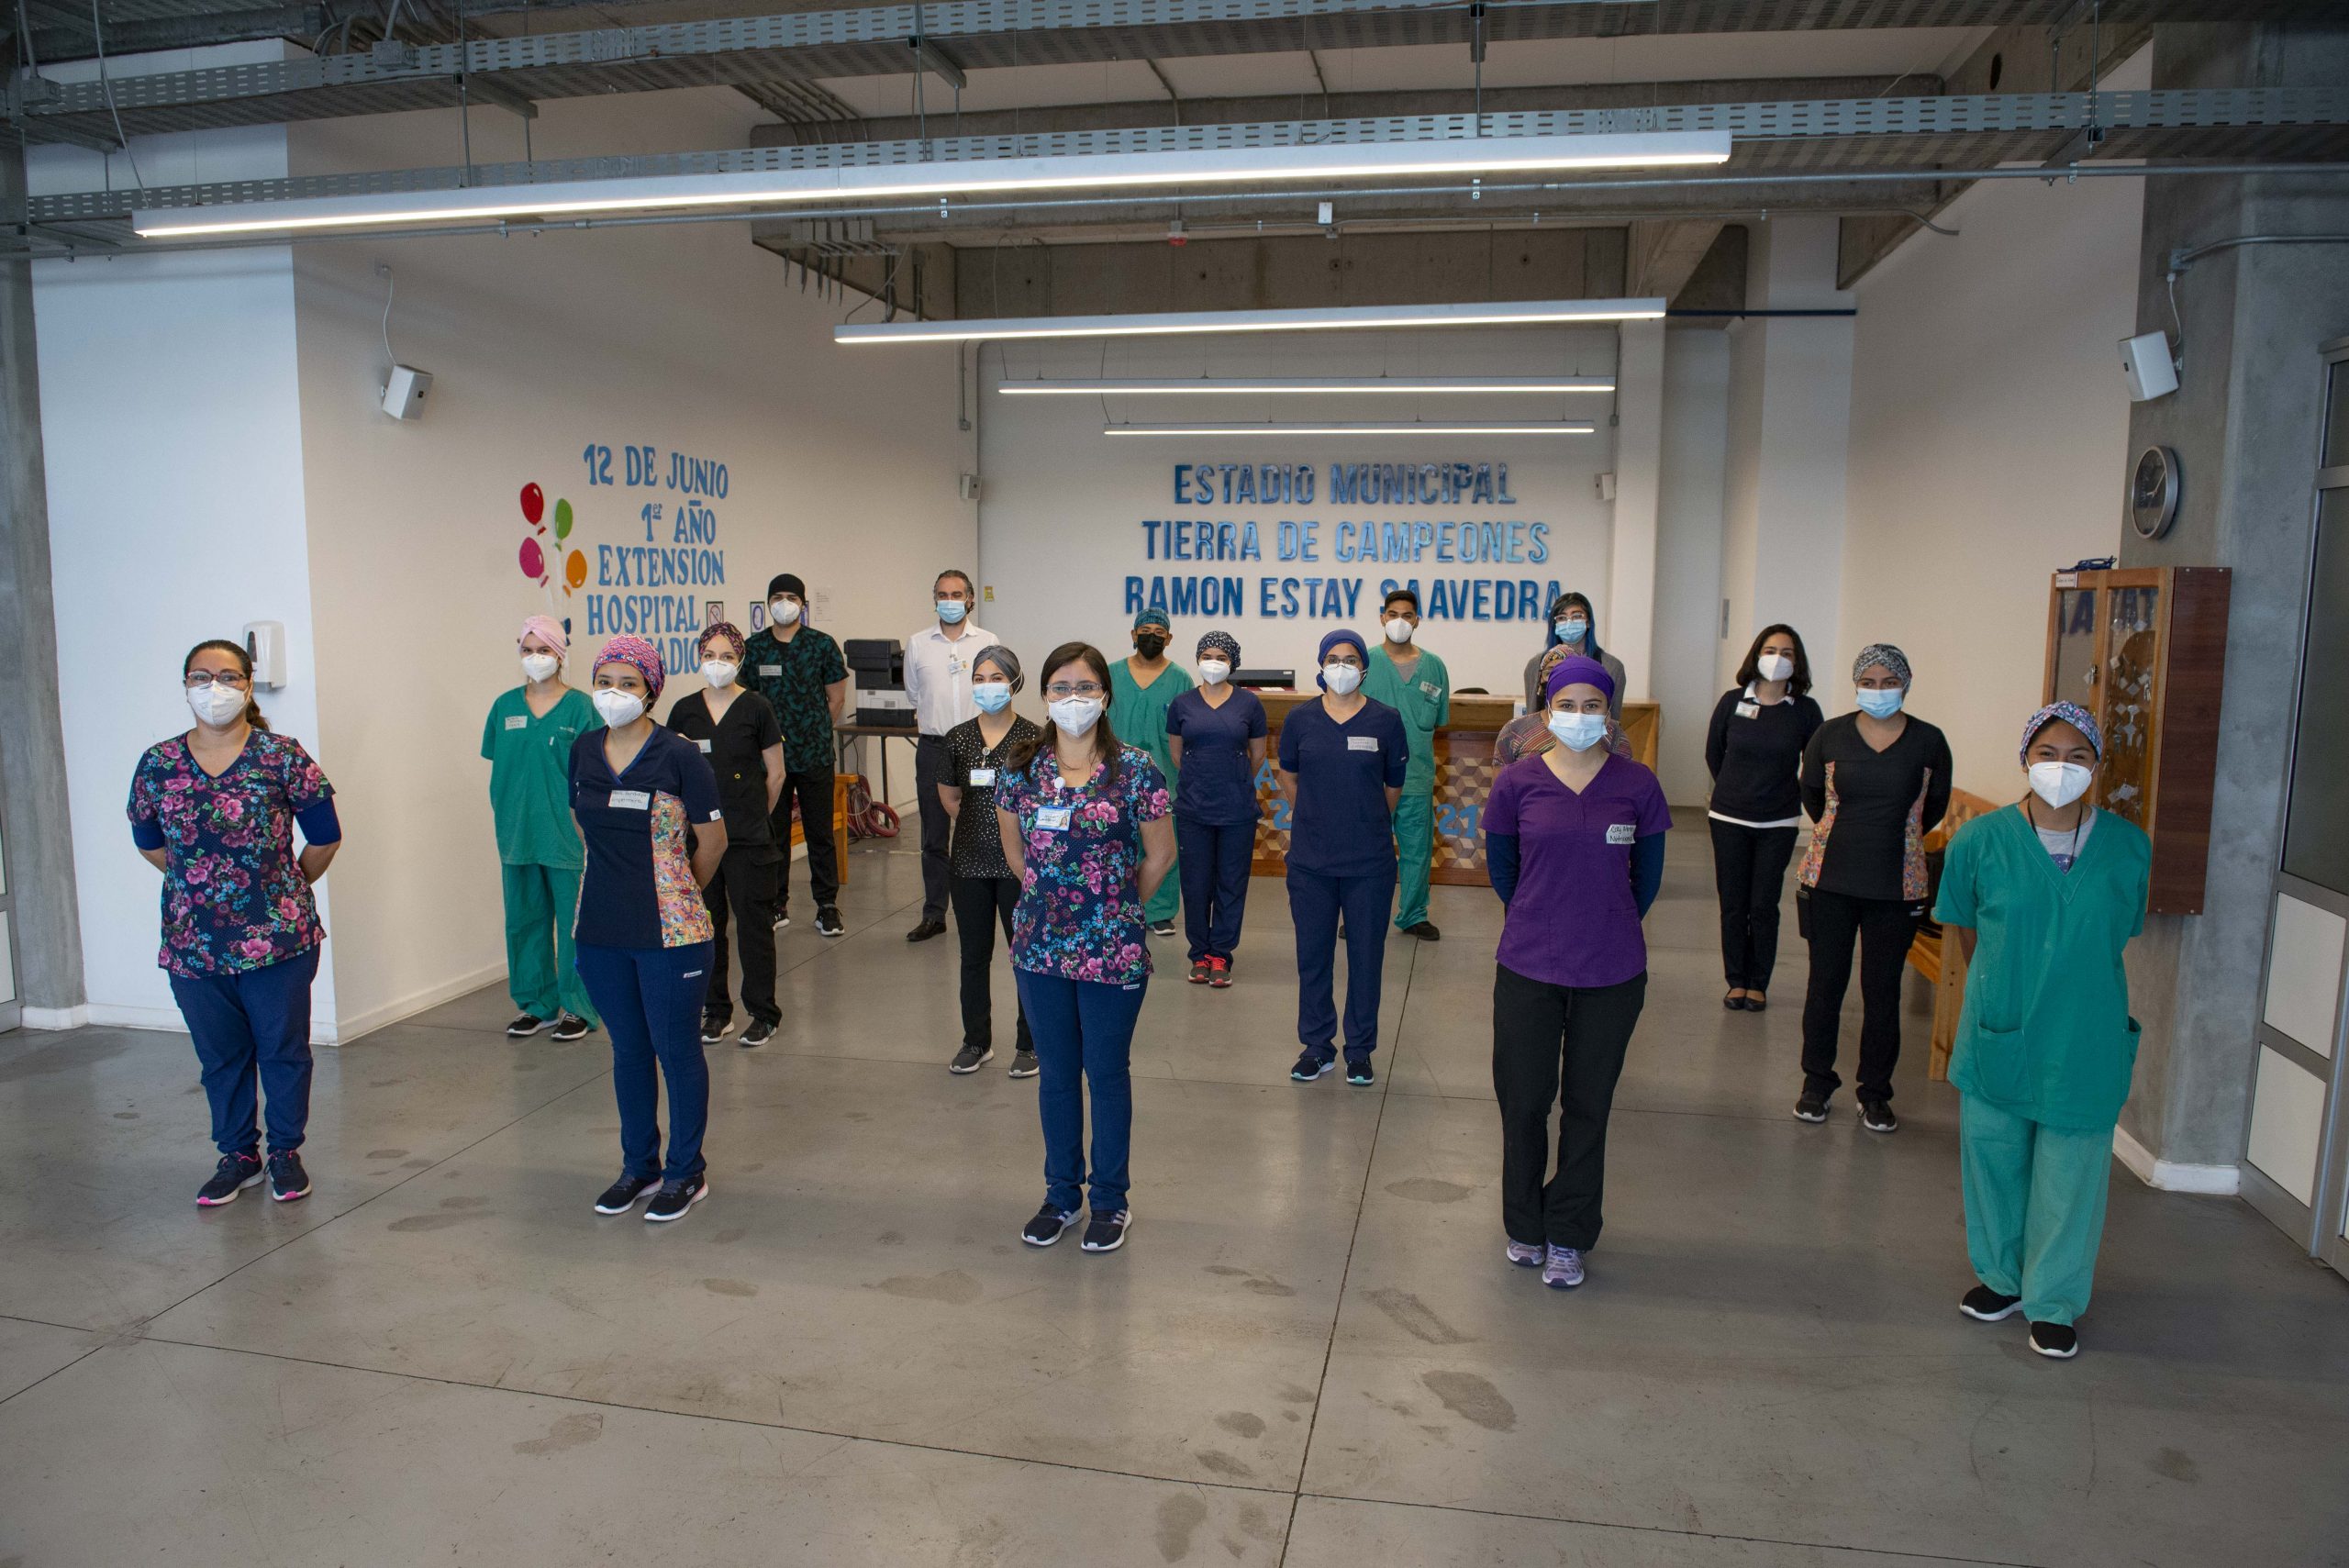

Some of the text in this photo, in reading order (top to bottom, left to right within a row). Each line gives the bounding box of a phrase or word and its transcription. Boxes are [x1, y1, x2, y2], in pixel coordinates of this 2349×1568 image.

[583, 443, 729, 499] 12 DE JUNIO
[1174, 463, 1516, 505] ESTADIO MUNICIPAL
[674, 499, 717, 545] AÑO
[1141, 520, 1550, 564] TIERRA DE CAMPEONES
[597, 544, 725, 588] EXTENSION
[586, 594, 701, 636] HOSPITAL
[1125, 575, 1244, 617] RAMON
[1260, 577, 1364, 618] ESTAY
[645, 637, 701, 675] ADIO
